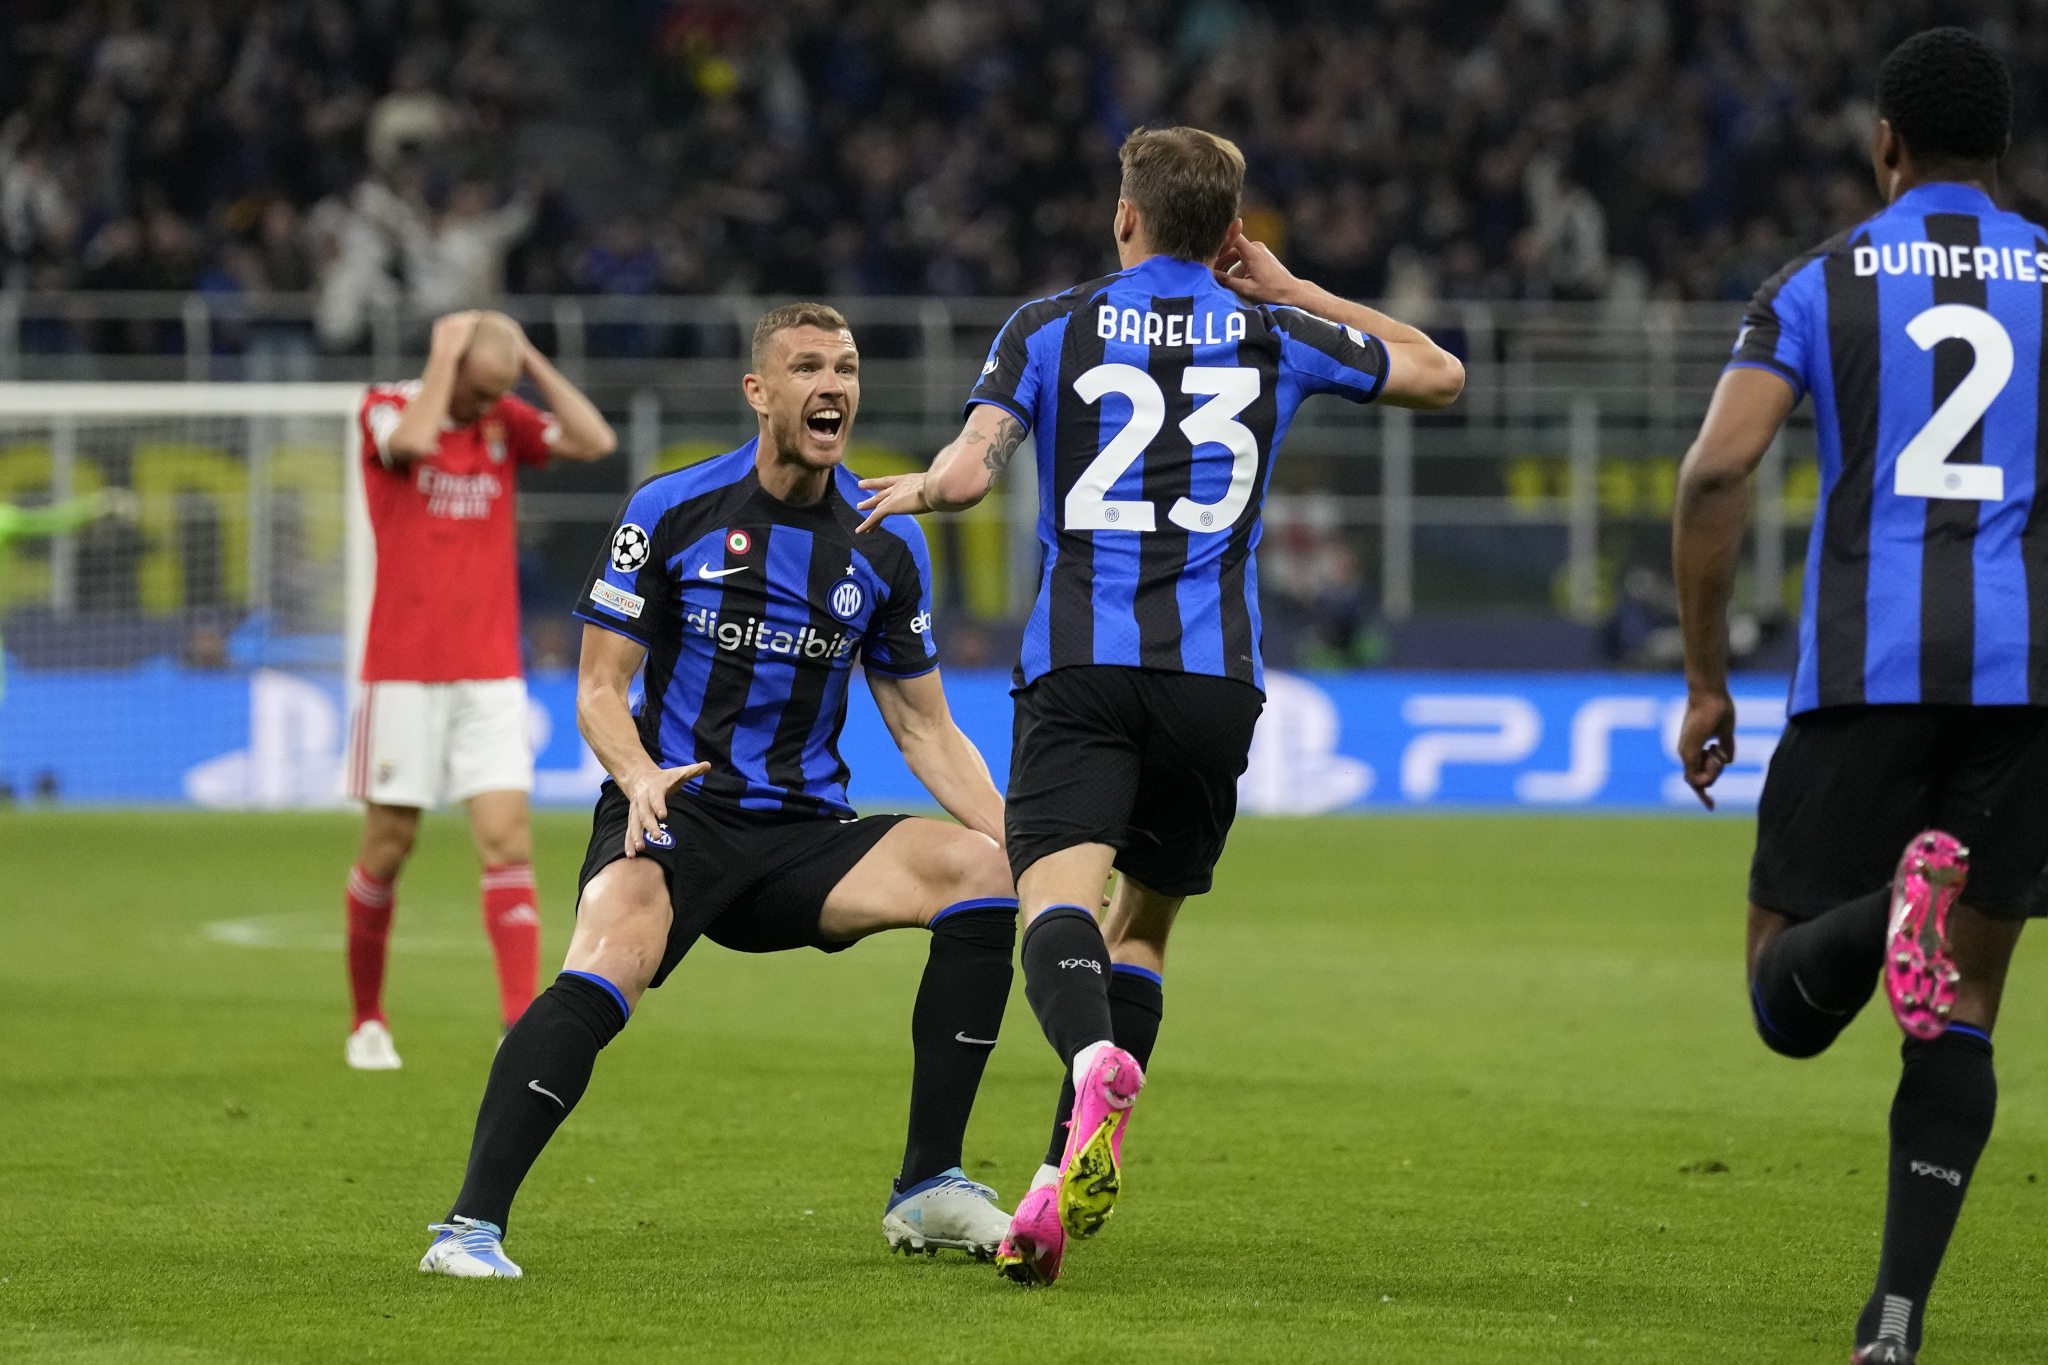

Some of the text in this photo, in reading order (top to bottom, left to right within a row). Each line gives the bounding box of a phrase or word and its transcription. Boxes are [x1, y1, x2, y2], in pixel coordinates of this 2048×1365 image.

[1097, 305, 1246, 347] BARELLA
[1894, 303, 2015, 500] 2
[1064, 363, 1261, 533] 23
[1058, 958, 1102, 975] 1908
[1910, 1161, 1962, 1187] 1908
